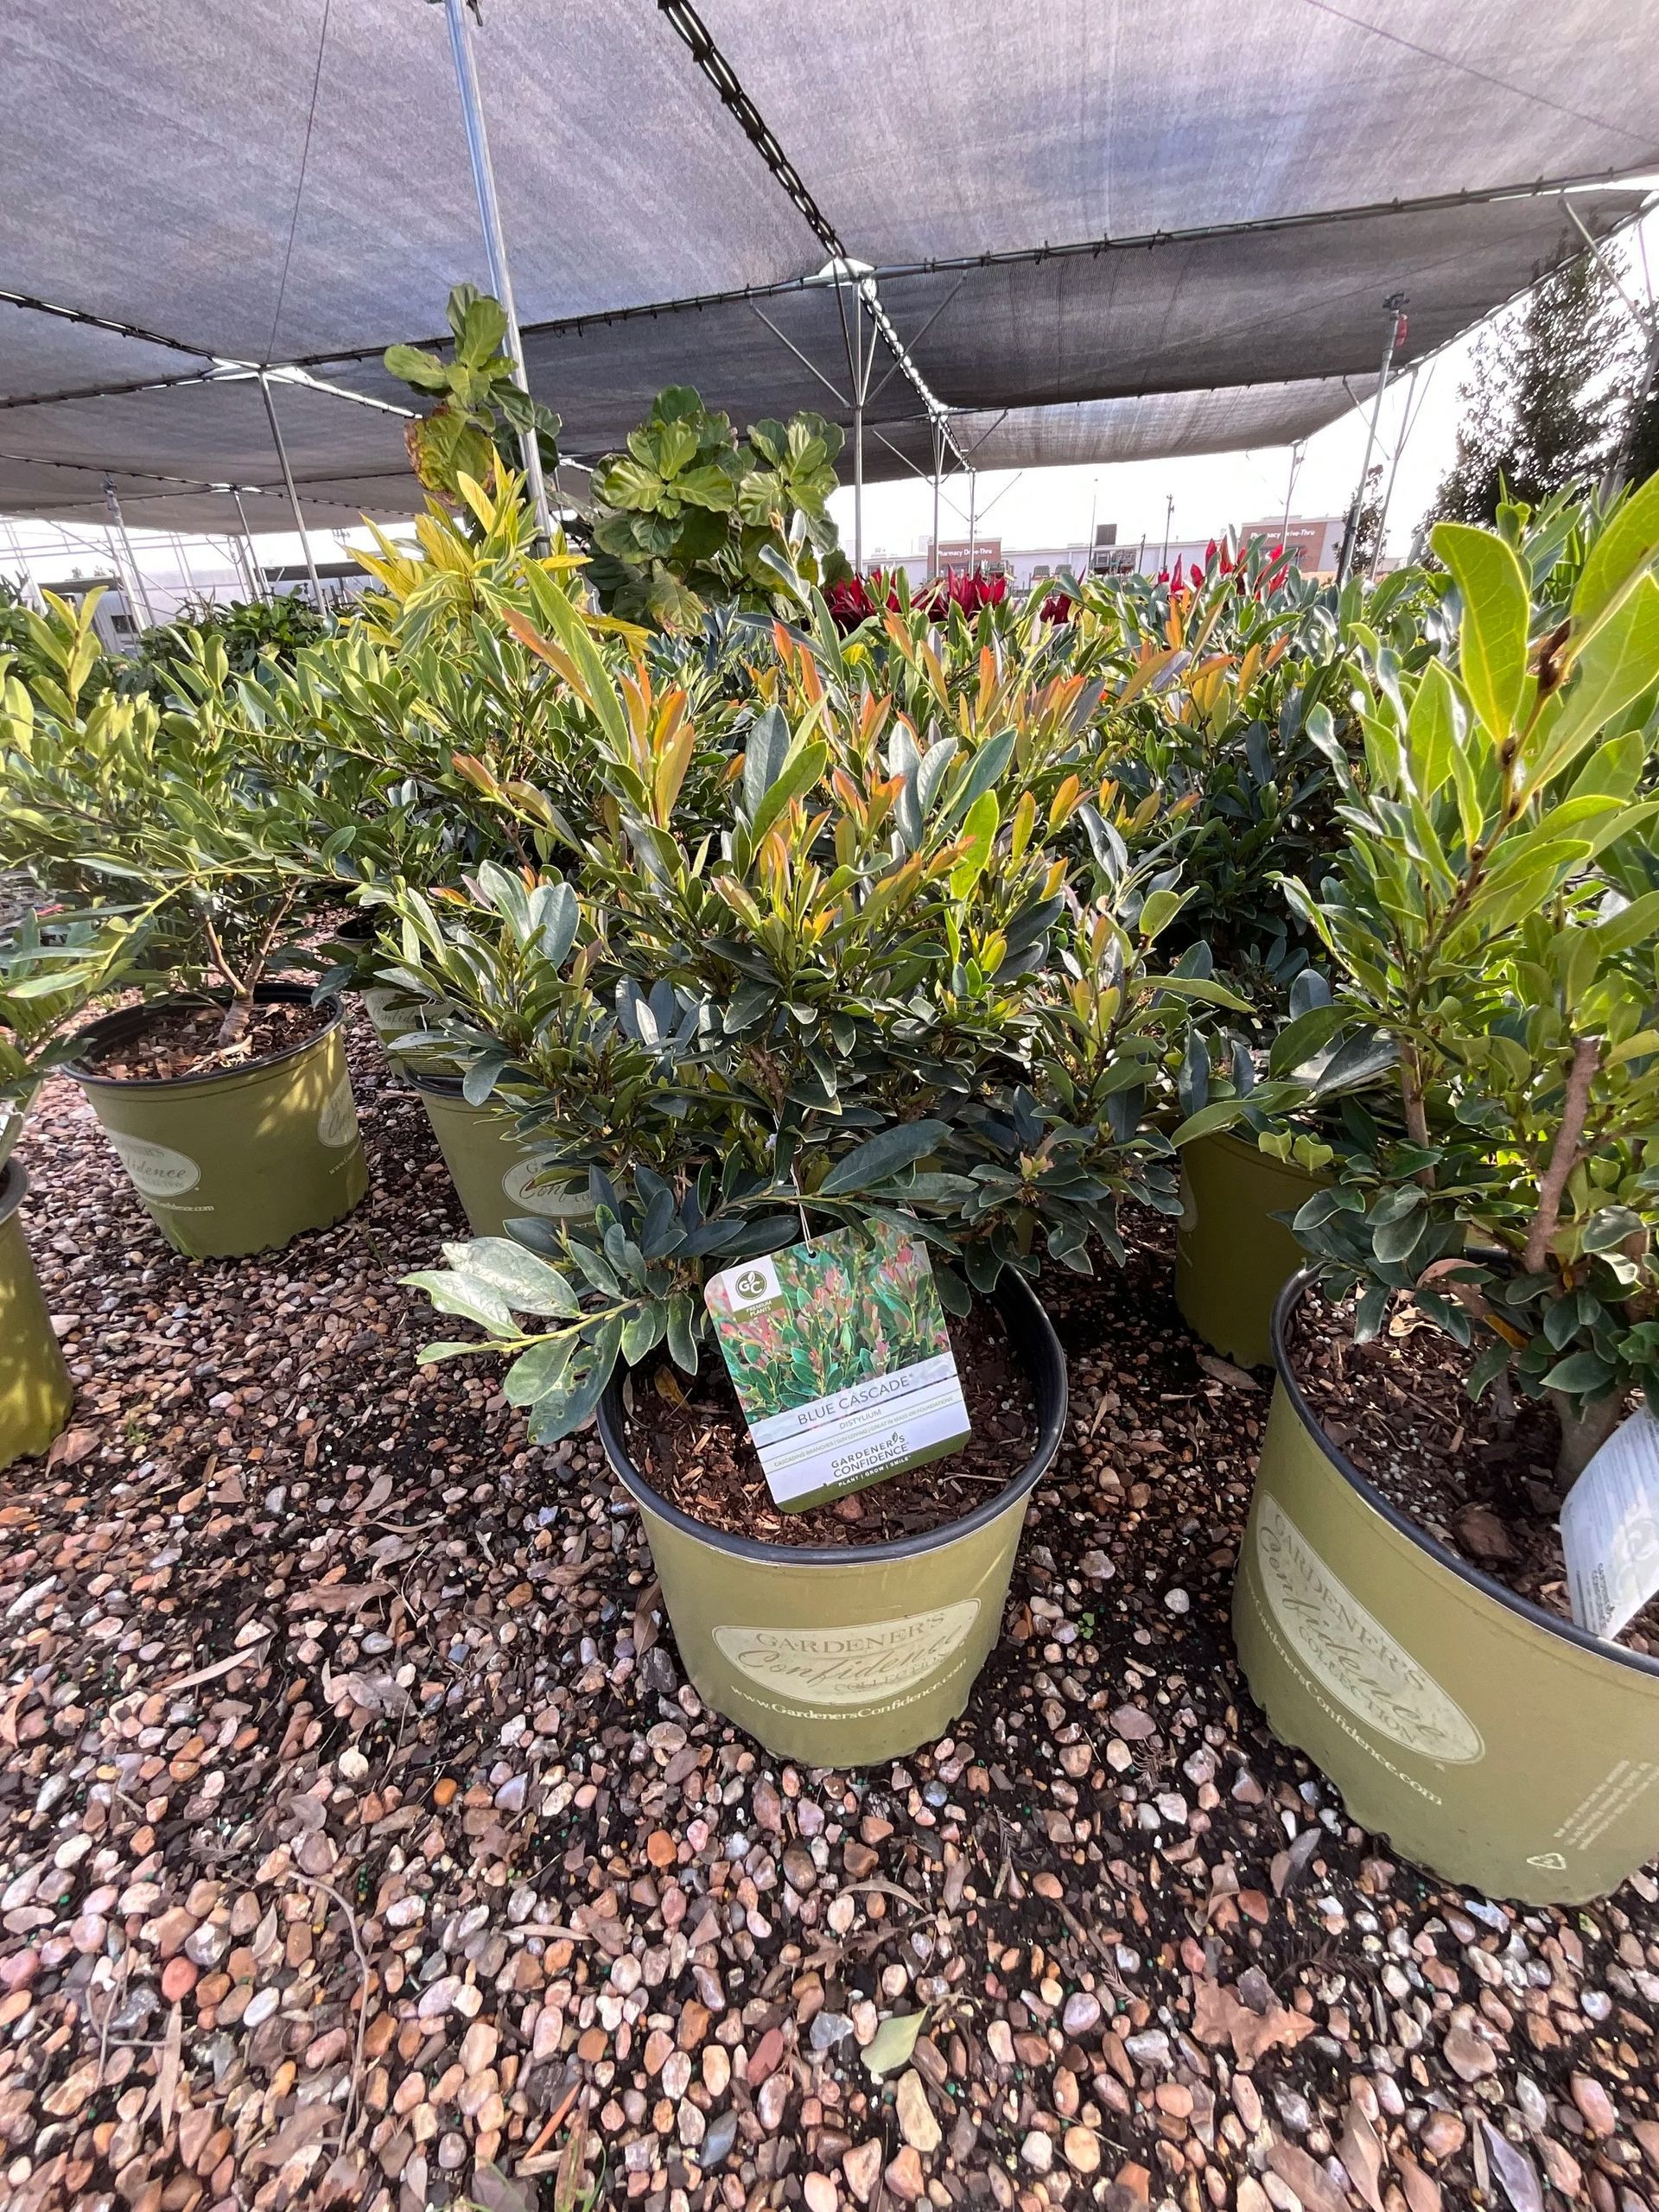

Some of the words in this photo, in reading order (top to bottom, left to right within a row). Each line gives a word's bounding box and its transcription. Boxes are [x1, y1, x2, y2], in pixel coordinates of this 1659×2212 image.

[747, 1300, 772, 1313] PREMIUM
[750, 1306, 772, 1317] PLANTS
[798, 1403, 836, 1425] BLUE
[839, 1376, 910, 1409] CASCADE
[840, 1408, 882, 1430] DISTYLIUM
[831, 1433, 906, 1468] GARDENER'S
[833, 1444, 908, 1478] CONFIDENCE
[838, 1476, 859, 1487] PLANT
[865, 1466, 884, 1477] GROW
[890, 1456, 909, 1467] SMILE
[1274, 1513, 1424, 1691] GARDENER'S
[755, 1612, 945, 1654] GARDENER'S
[1260, 1525, 1446, 1738] Confidence
[738, 1624, 963, 1688] Confidence
[730, 1657, 967, 1720] www.GardenersConfidence.com
[1246, 1566, 1442, 1805] GardenersConfidence.com
[1299, 1625, 1414, 1744] COLLECTION
